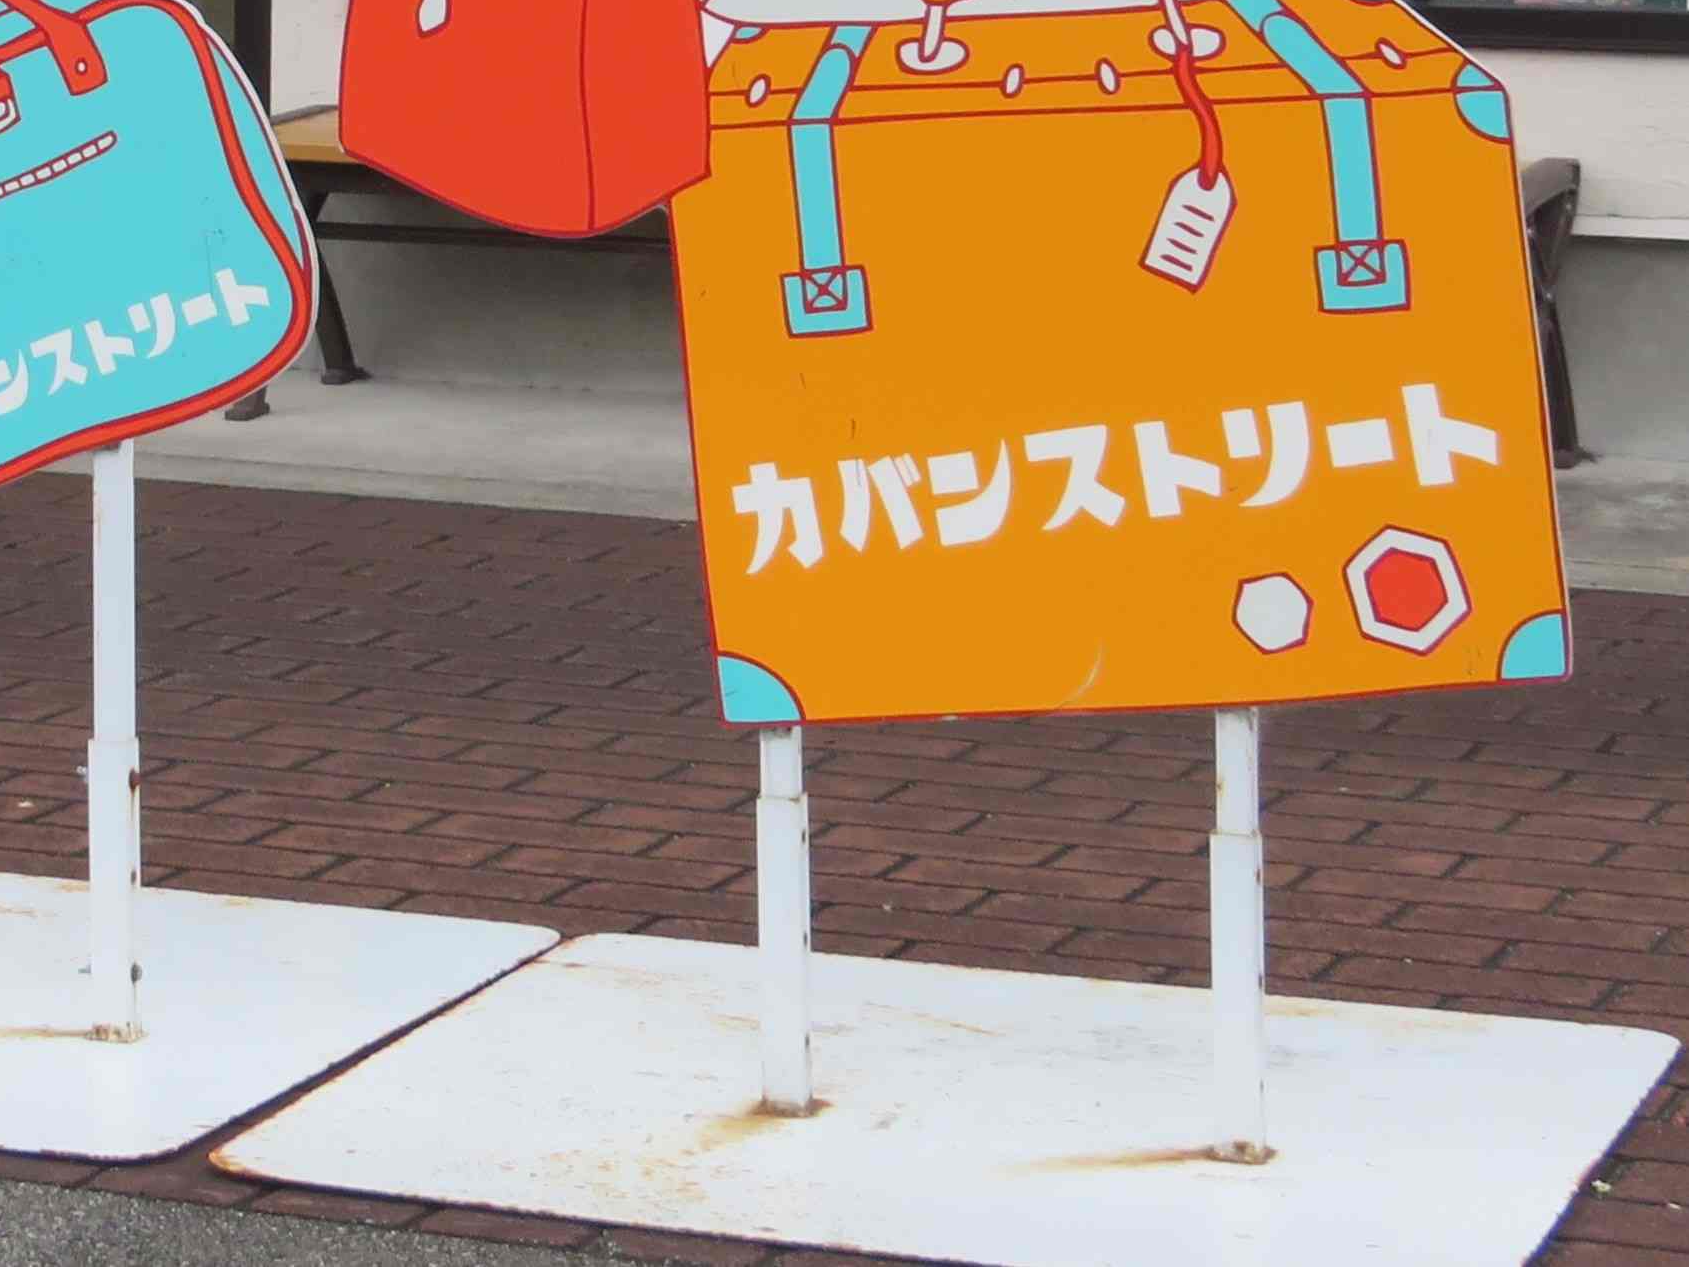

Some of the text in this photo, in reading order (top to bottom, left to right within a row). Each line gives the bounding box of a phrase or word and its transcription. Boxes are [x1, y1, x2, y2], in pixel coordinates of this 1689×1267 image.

[731, 382, 1499, 575] カバンストリート
